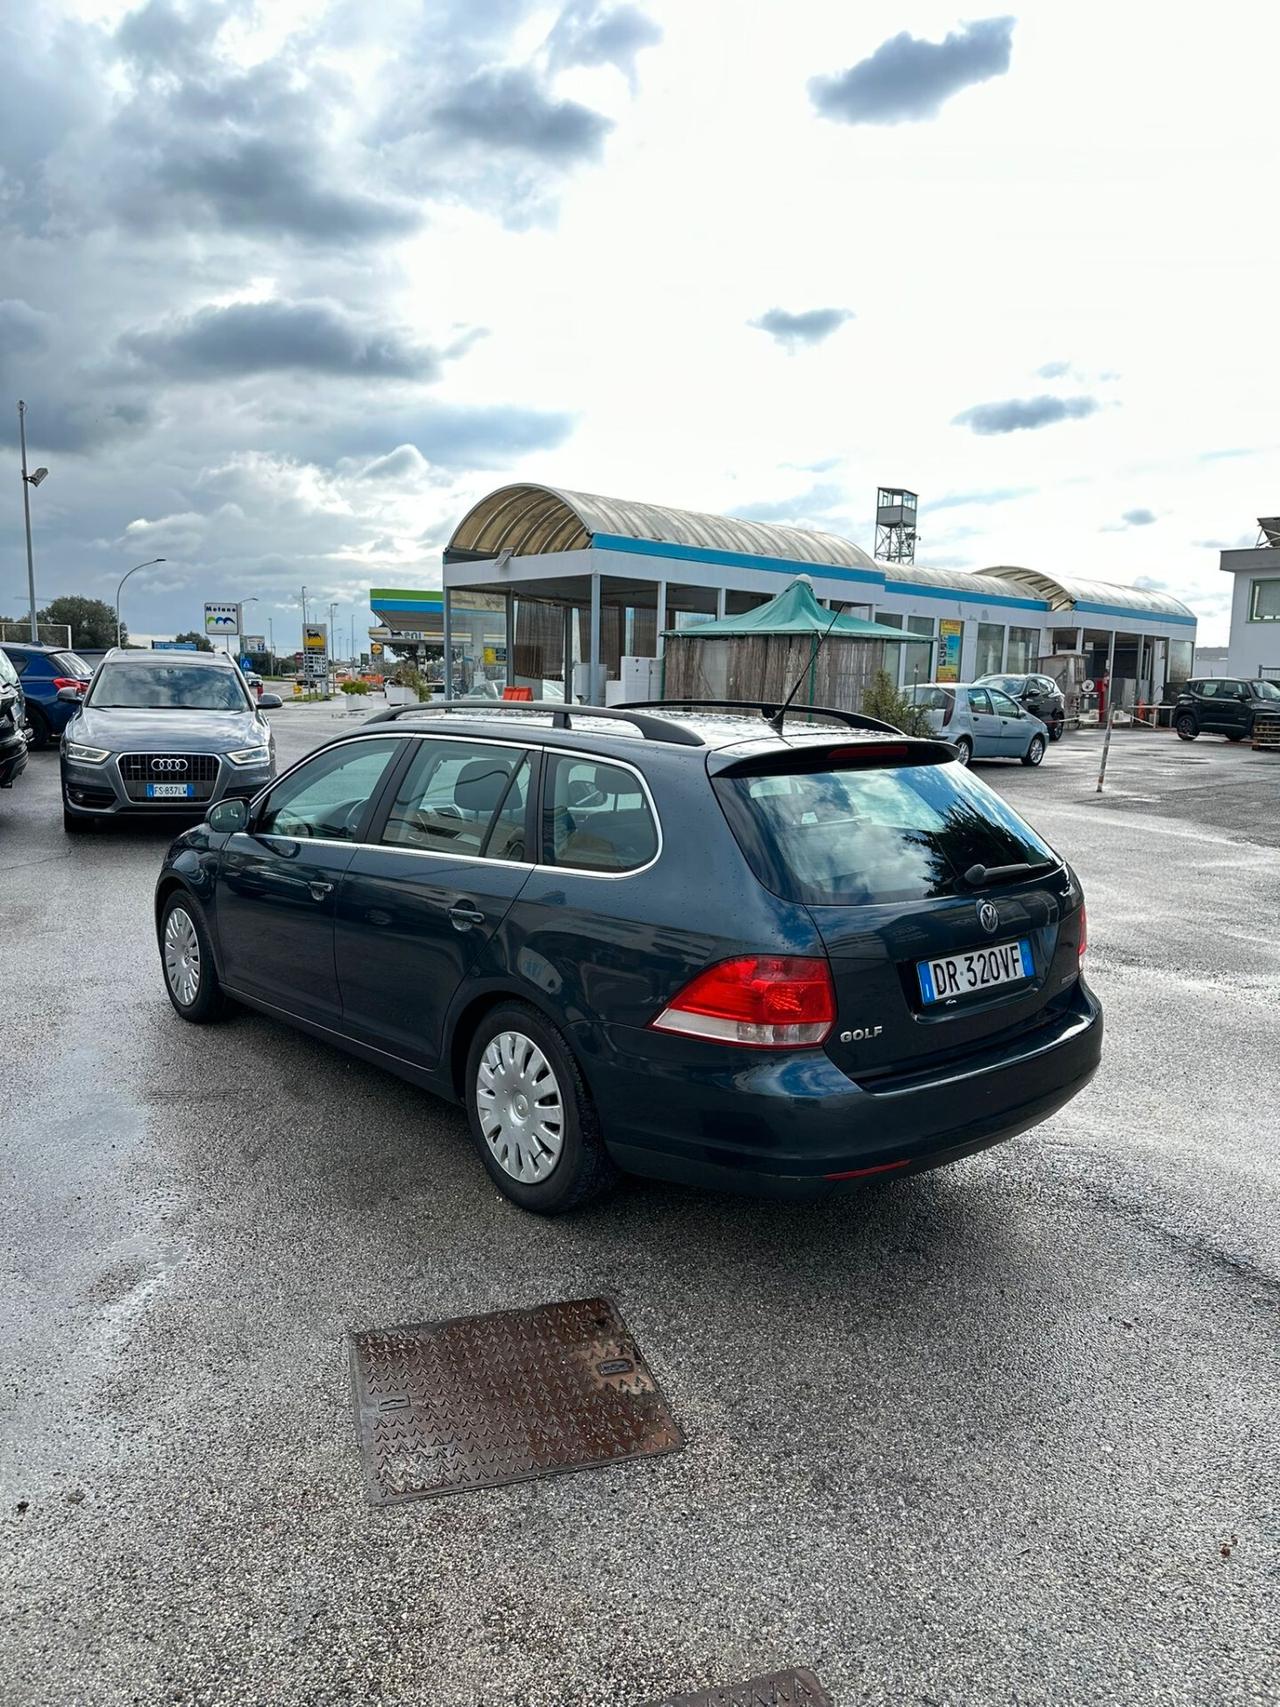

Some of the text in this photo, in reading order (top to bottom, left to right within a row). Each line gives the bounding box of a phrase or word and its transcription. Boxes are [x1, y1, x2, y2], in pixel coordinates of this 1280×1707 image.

[404, 631, 422, 639] eni
[932, 945, 1020, 996] DR 320VF
[840, 1025, 883, 1043] GOLF
